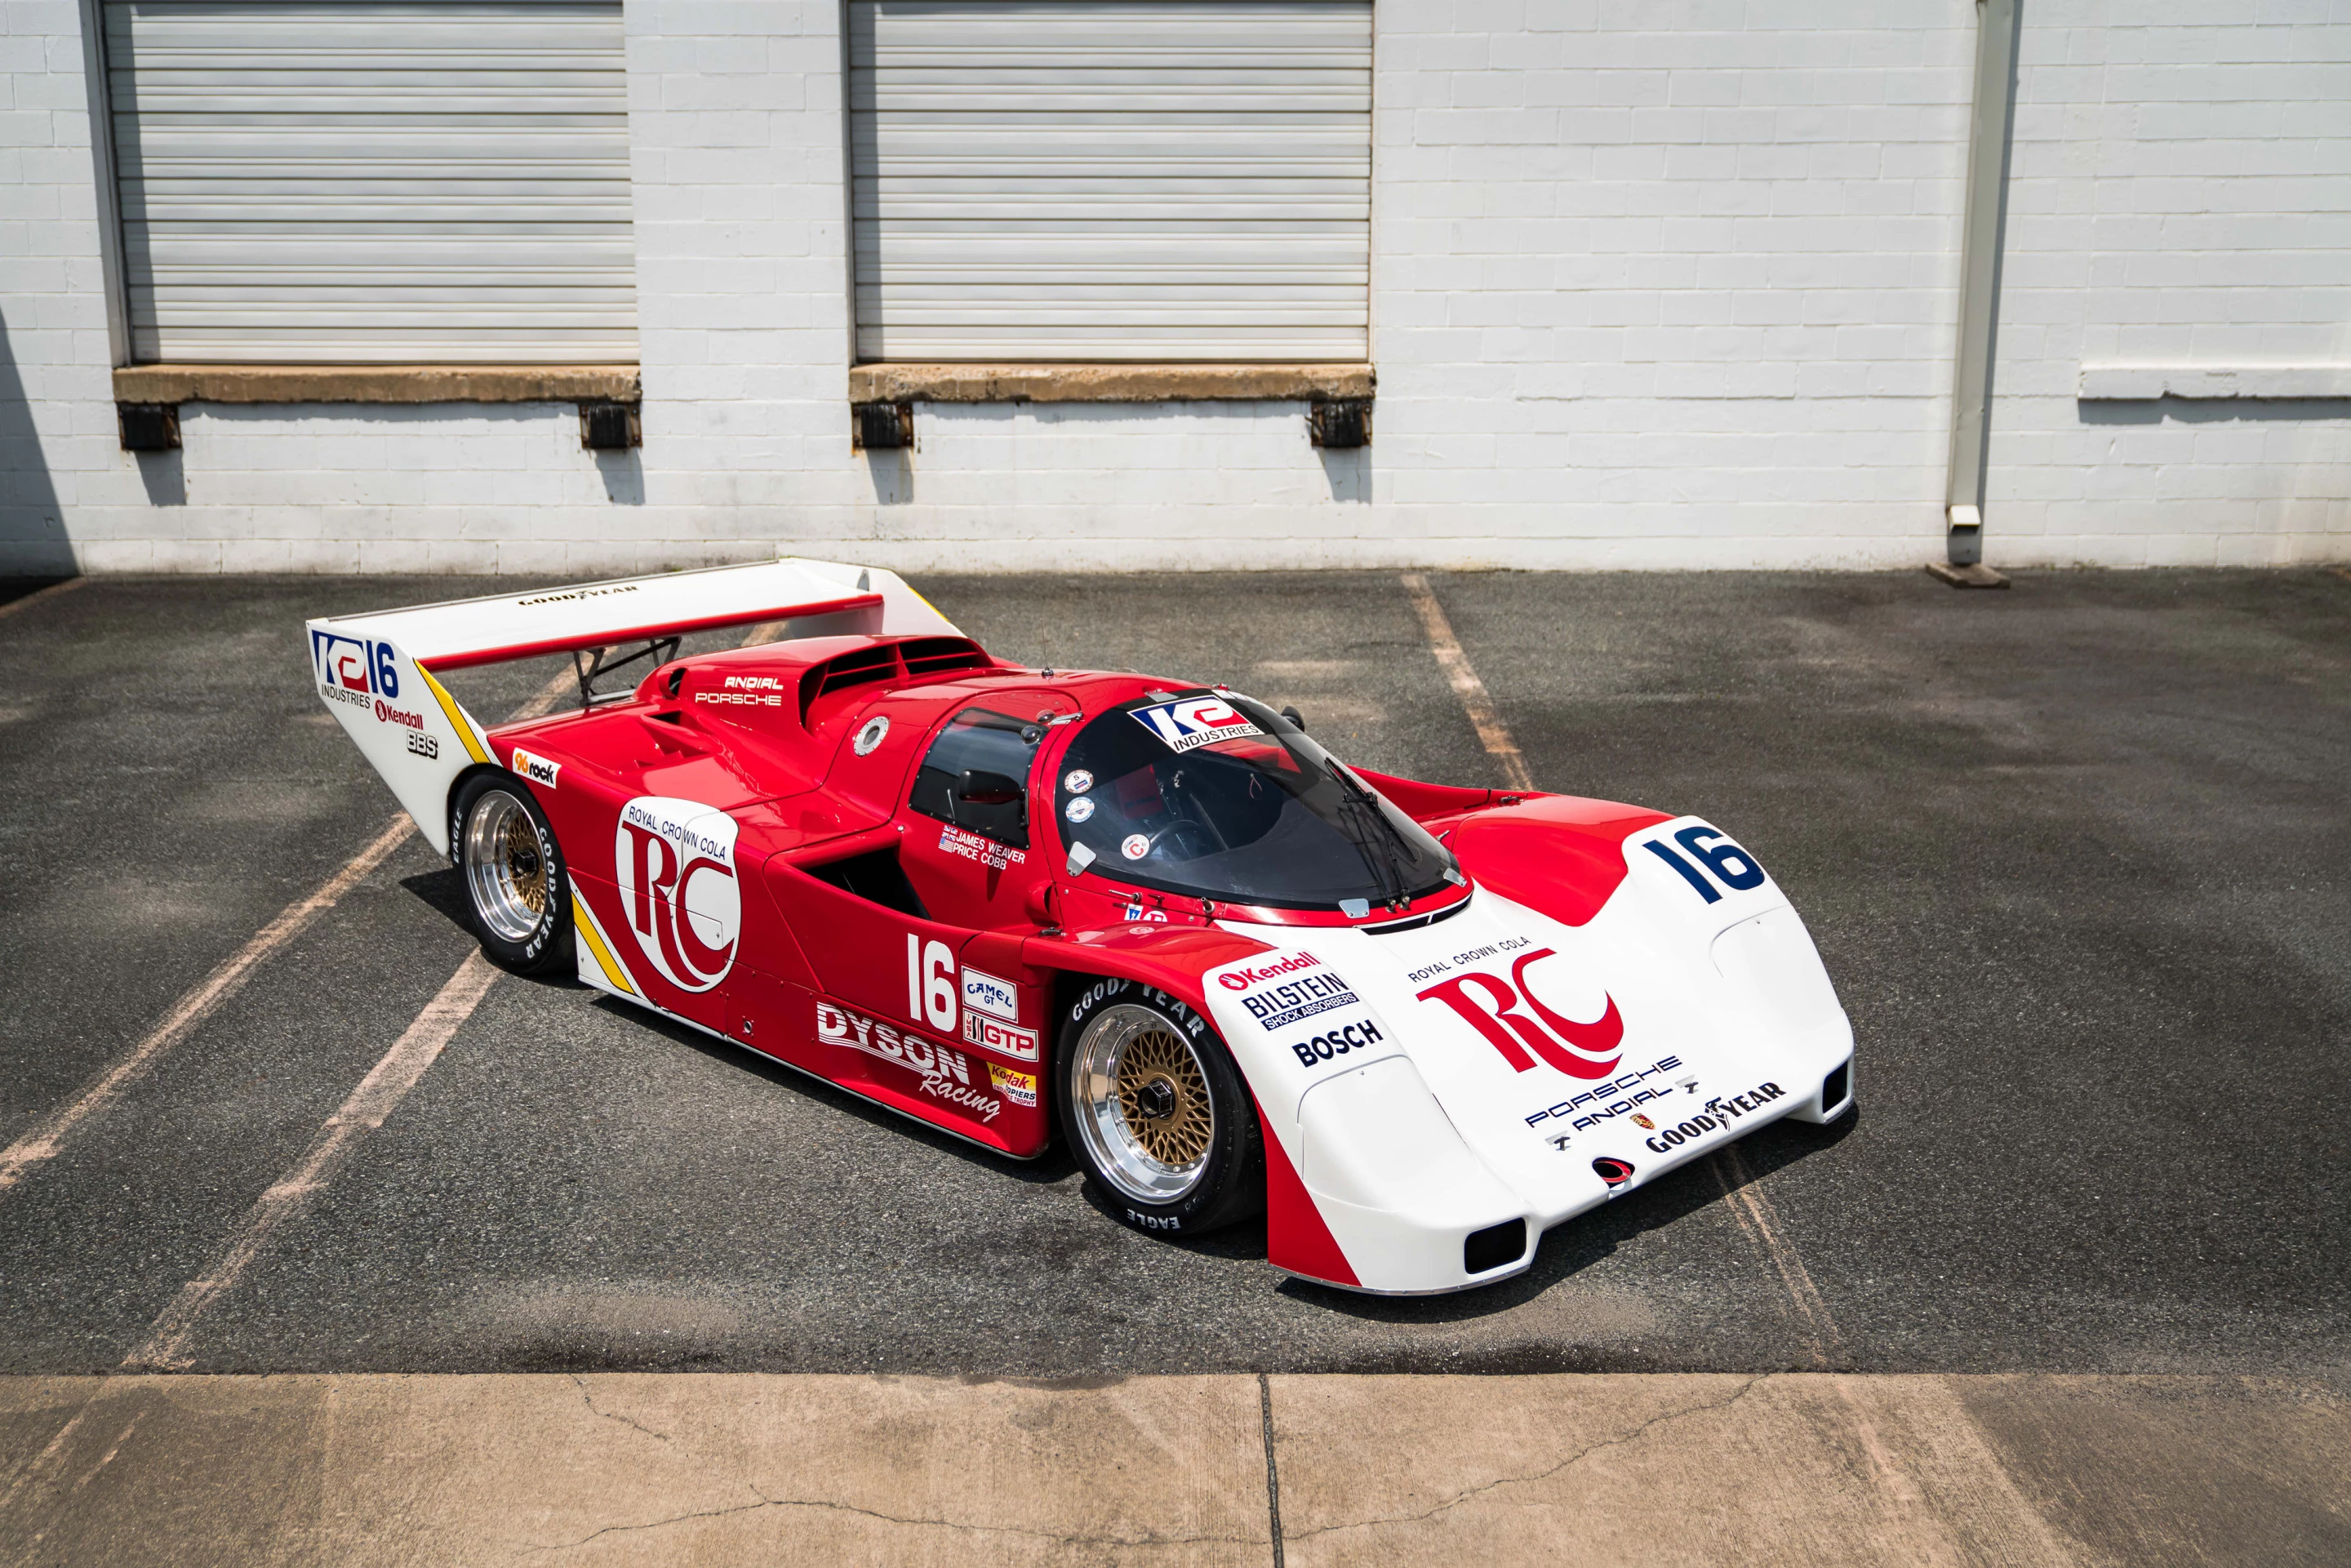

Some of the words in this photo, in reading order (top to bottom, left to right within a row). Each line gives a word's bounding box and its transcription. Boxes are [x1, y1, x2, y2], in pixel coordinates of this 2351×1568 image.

[518, 586, 639, 606] GOODYEAR
[366, 639, 399, 699] 16
[725, 677, 784, 690] ANDIAL
[321, 684, 371, 709] INDUSTRIES
[695, 692, 782, 706] PORSCHE
[387, 705, 424, 730] Kendall
[407, 730, 438, 760] BBS
[1173, 725, 1260, 752] INDUSTRIES
[529, 762, 554, 784] rock
[453, 806, 462, 864] EAGLE
[629, 806, 657, 830] ROYAL
[661, 820, 699, 848] CROWN
[700, 837, 727, 860] COLA
[955, 831, 985, 851] JAMES
[988, 842, 1026, 864] WEAVER
[952, 843, 978, 861] PRICE
[980, 854, 1007, 871] COBB
[1642, 826, 1766, 905] 16
[526, 827, 556, 959] GOODYEAR
[621, 820, 736, 988] RC
[1238, 951, 1322, 984] Kendall
[1407, 962, 1452, 984] ROYAL
[1453, 944, 1499, 966] CROWN
[1499, 935, 1532, 952] COLA
[908, 933, 957, 1033] 16
[967, 983, 1013, 1008] CAMEL
[984, 995, 994, 1006] GT
[1241, 972, 1349, 1019] BILSTEIN
[1073, 978, 1205, 1038] GOODYEAR
[1264, 1007, 1304, 1030] SHOCK
[1303, 993, 1357, 1017] ABSORBERS
[1415, 947, 1624, 1080] RC
[816, 1002, 970, 1086] DYSON
[984, 1024, 1034, 1052] GTP
[1291, 1019, 1384, 1068] BOSCH
[919, 1070, 1000, 1122] Racing
[992, 1065, 1030, 1090] Kodak
[1524, 1055, 1683, 1128] PORSCHE
[1014, 1096, 1036, 1106] TROPHY
[1572, 1087, 1673, 1131] ANDIAL
[1645, 1082, 1787, 1153] GOODYEAR
[1127, 1208, 1181, 1229] EAGLE
